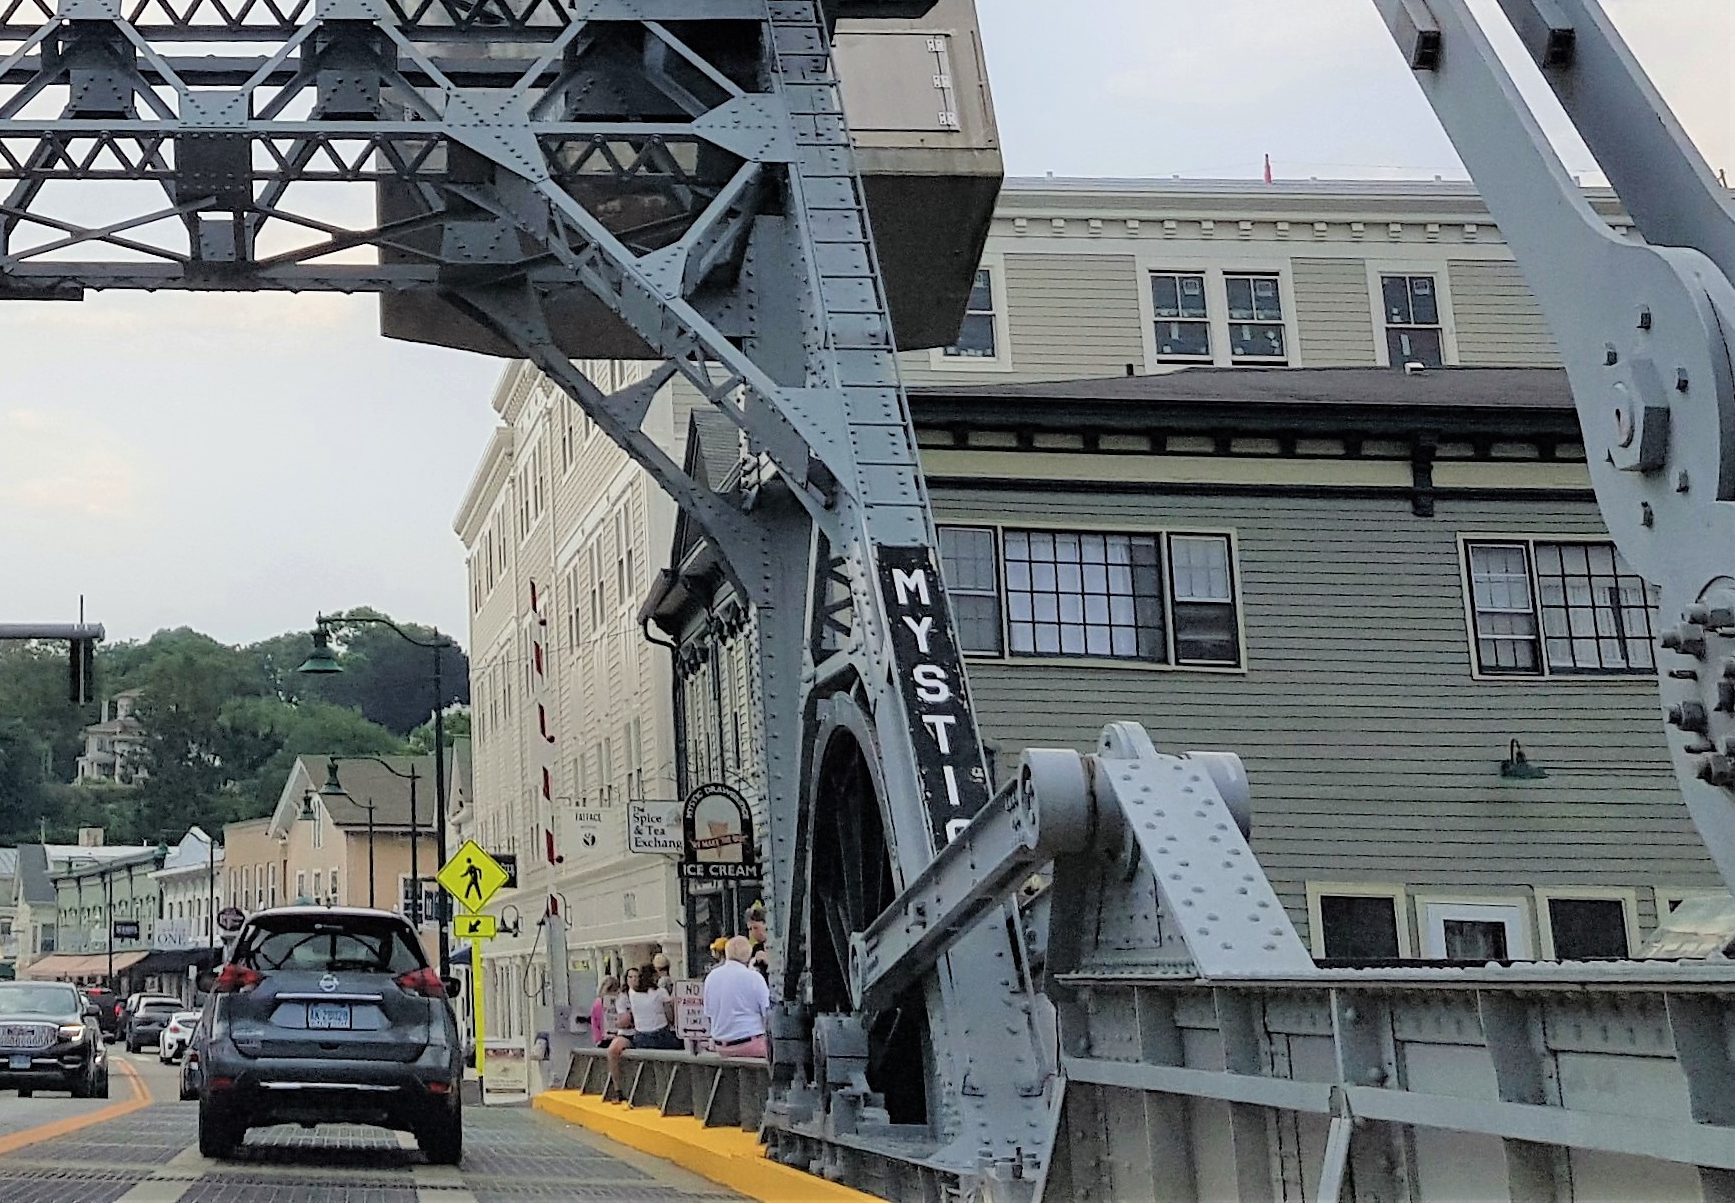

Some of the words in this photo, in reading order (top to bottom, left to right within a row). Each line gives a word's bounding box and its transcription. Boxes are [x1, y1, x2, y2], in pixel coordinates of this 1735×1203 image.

[633, 812, 662, 826] Spice
[633, 825, 643, 835] &
[645, 825, 666, 836] Tea
[634, 837, 683, 851] Exchang
[683, 864, 704, 876] ICE
[708, 864, 757, 877] CREAM
[686, 985, 700, 996] NO
[678, 999, 704, 1007] PARKIN
